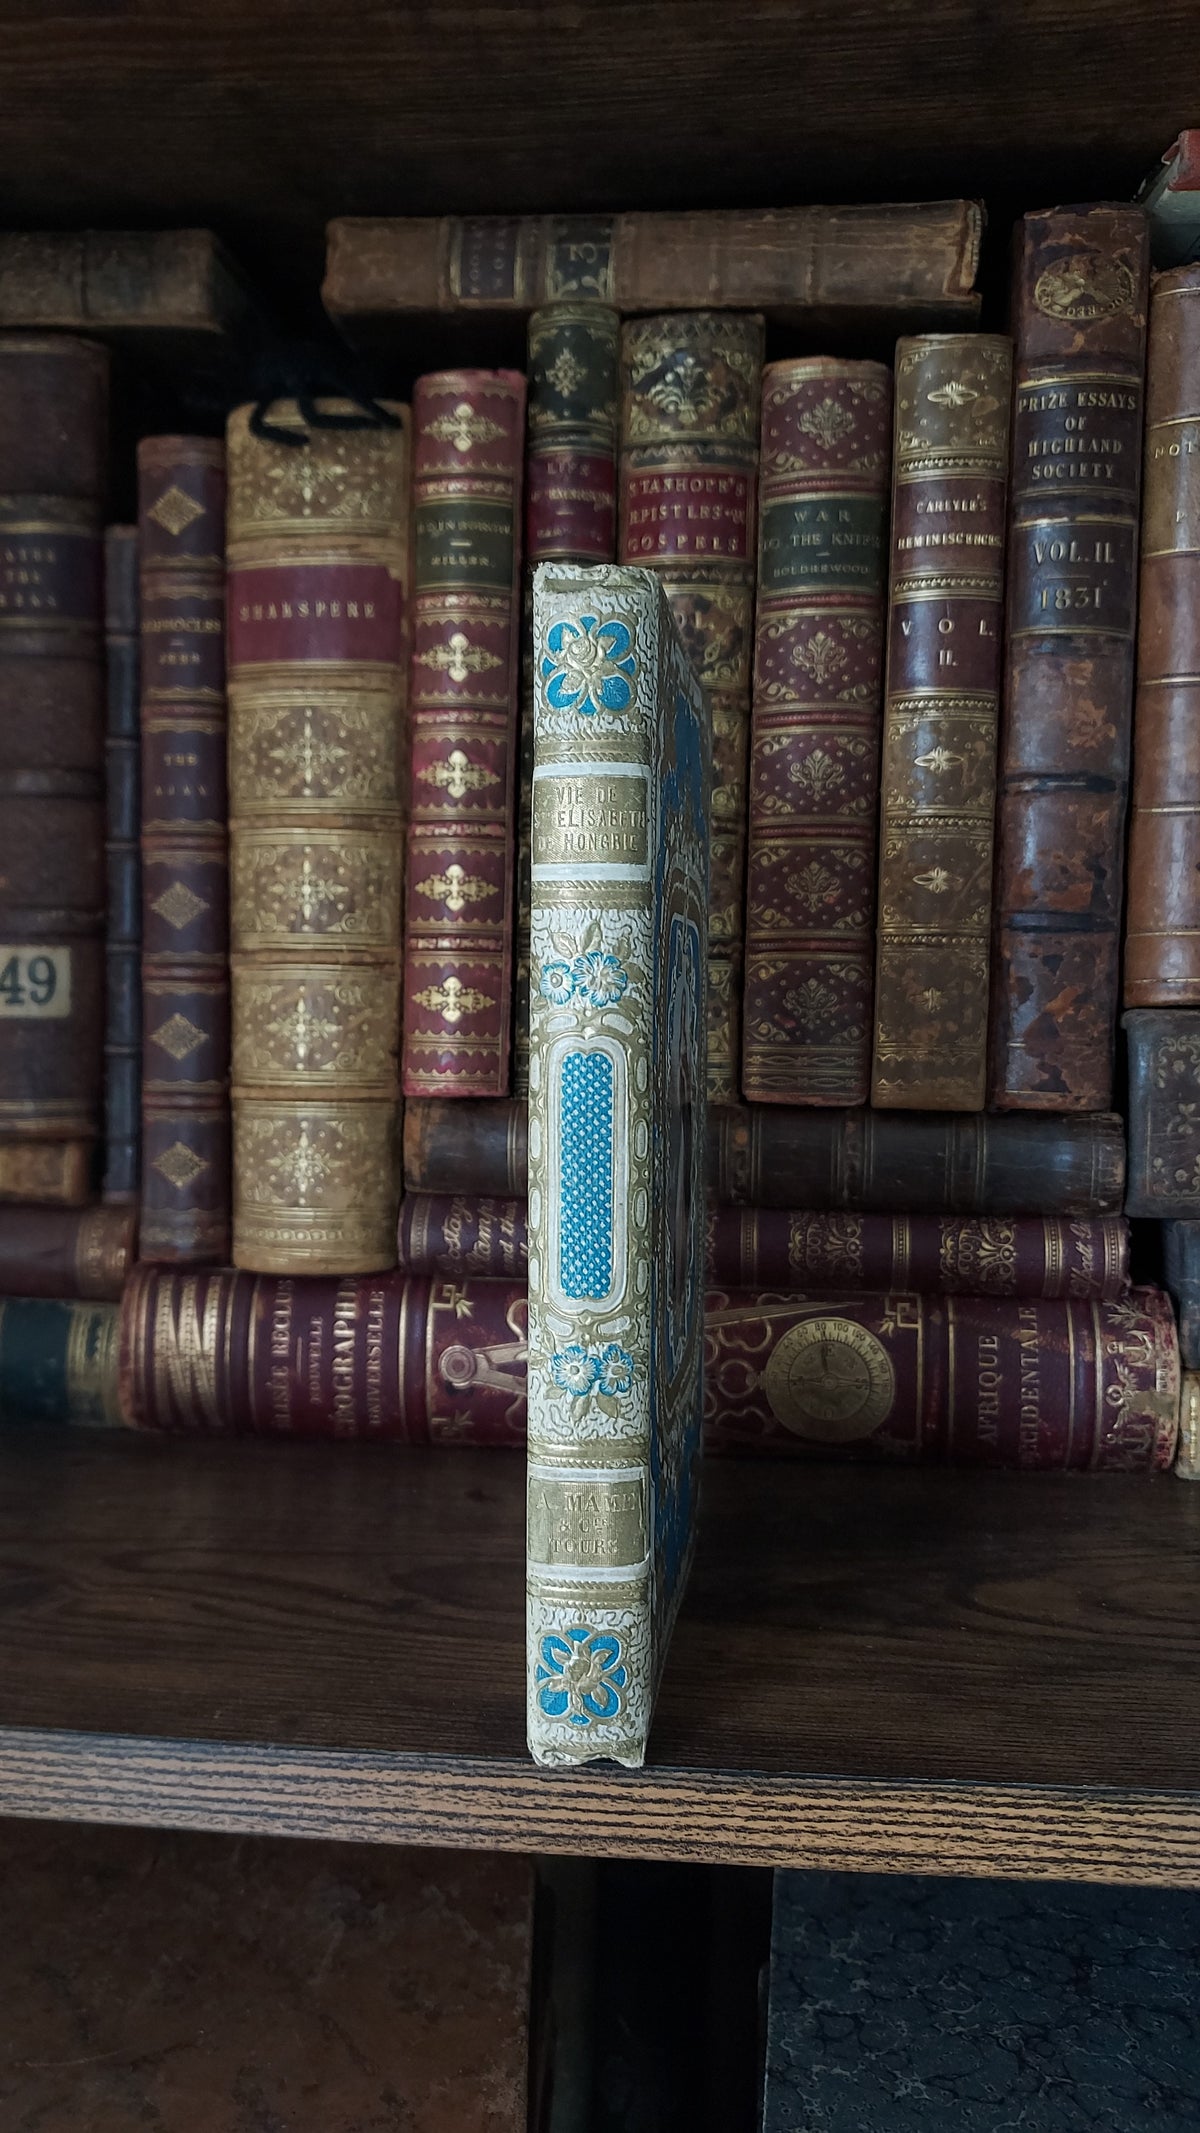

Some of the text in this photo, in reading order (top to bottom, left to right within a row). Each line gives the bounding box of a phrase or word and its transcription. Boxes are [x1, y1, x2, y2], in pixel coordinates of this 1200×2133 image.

[1019, 390, 1136, 413] PRIZE ESSAYS
[1065, 416, 1087, 431] OF
[1028, 438, 1122, 457] HIGHLAND
[1032, 462, 1115, 480] SOCIETY
[794, 509, 851, 522] WAR
[627, 532, 739, 552] GOSPELS
[791, 533, 823, 547] THE
[1041, 587, 1101, 610] 1831
[555, 785, 617, 805] VIE DE
[563, 832, 638, 852] HONGRIE
[0, 955, 57, 1006] 49
[977, 1335, 1003, 1447] AFRIQUE
[564, 1491, 636, 1513] MAME
[547, 1539, 619, 1555] TOURS
